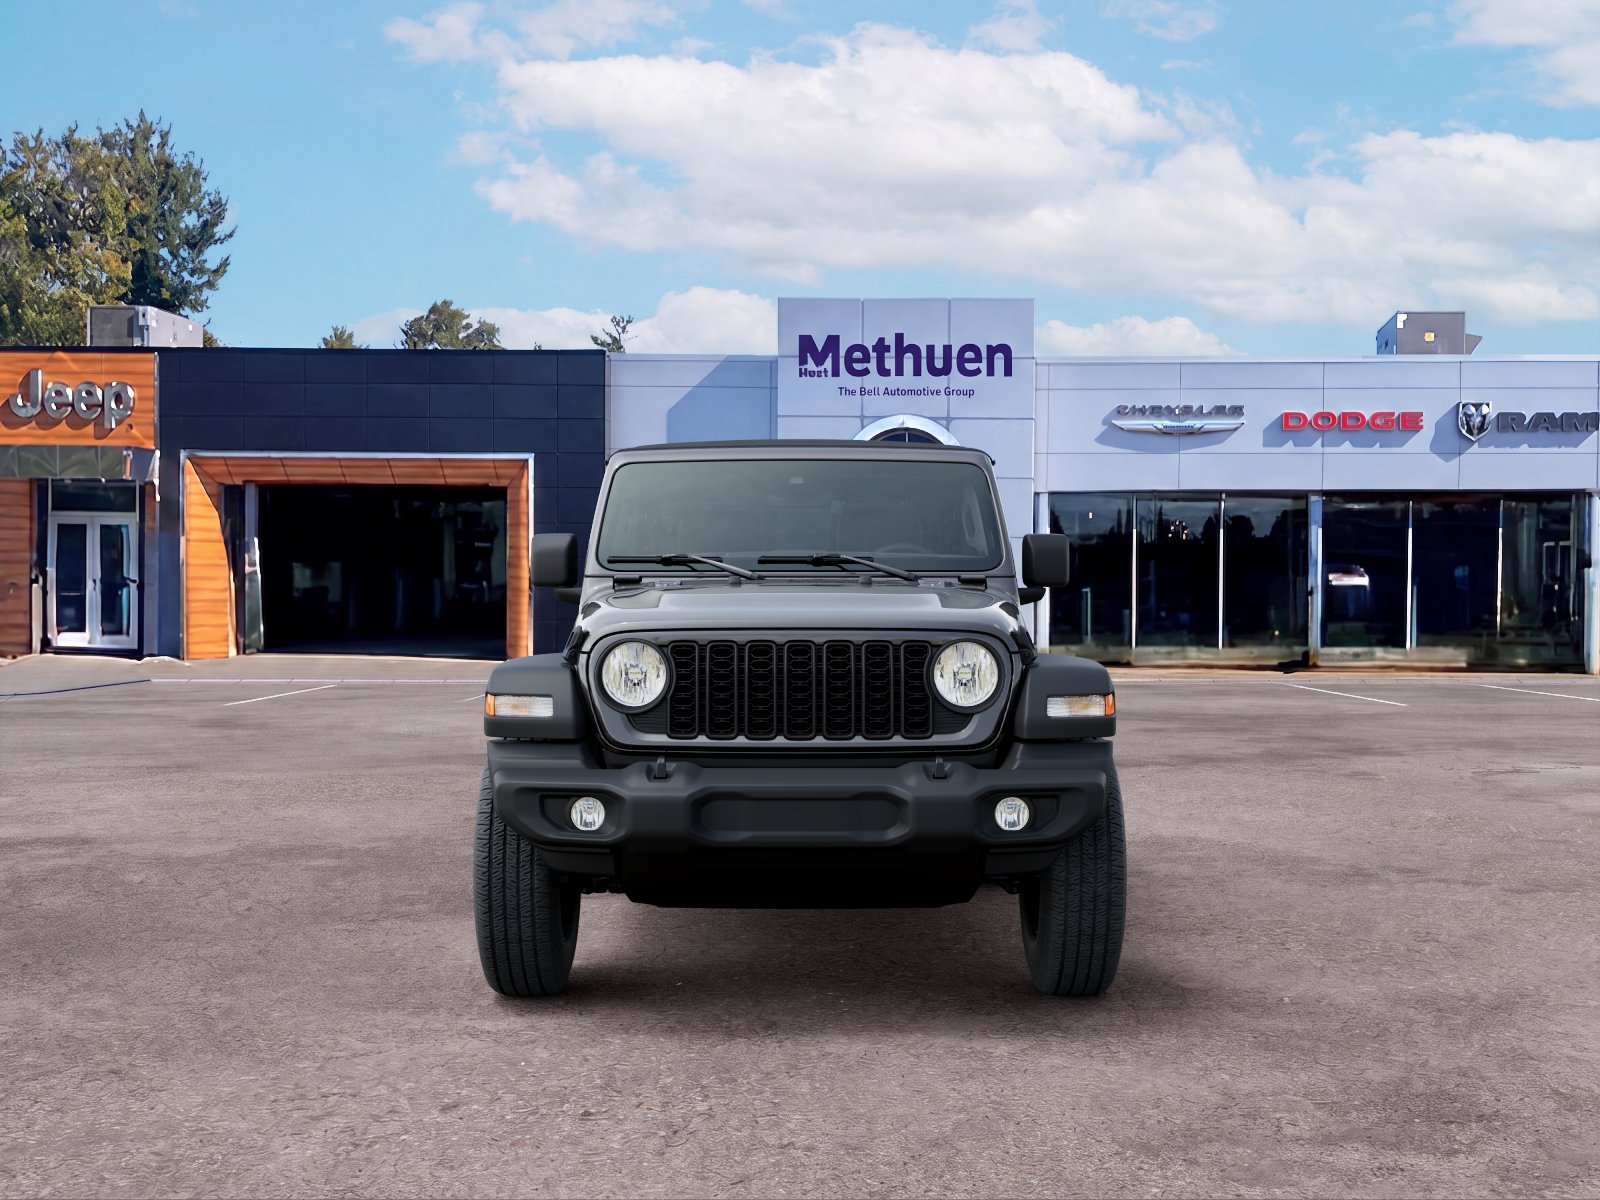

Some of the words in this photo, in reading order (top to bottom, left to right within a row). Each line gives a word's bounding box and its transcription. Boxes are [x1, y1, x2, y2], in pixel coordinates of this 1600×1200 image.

[798, 333, 1013, 377] Methuen
[9, 368, 135, 429] Jeep
[838, 387, 857, 396] The
[859, 387, 880, 396] Bell
[883, 387, 942, 396] Automotive
[944, 386, 975, 398] Group
[1282, 411, 1424, 431] DODGE
[1498, 411, 1599, 432] RAM
